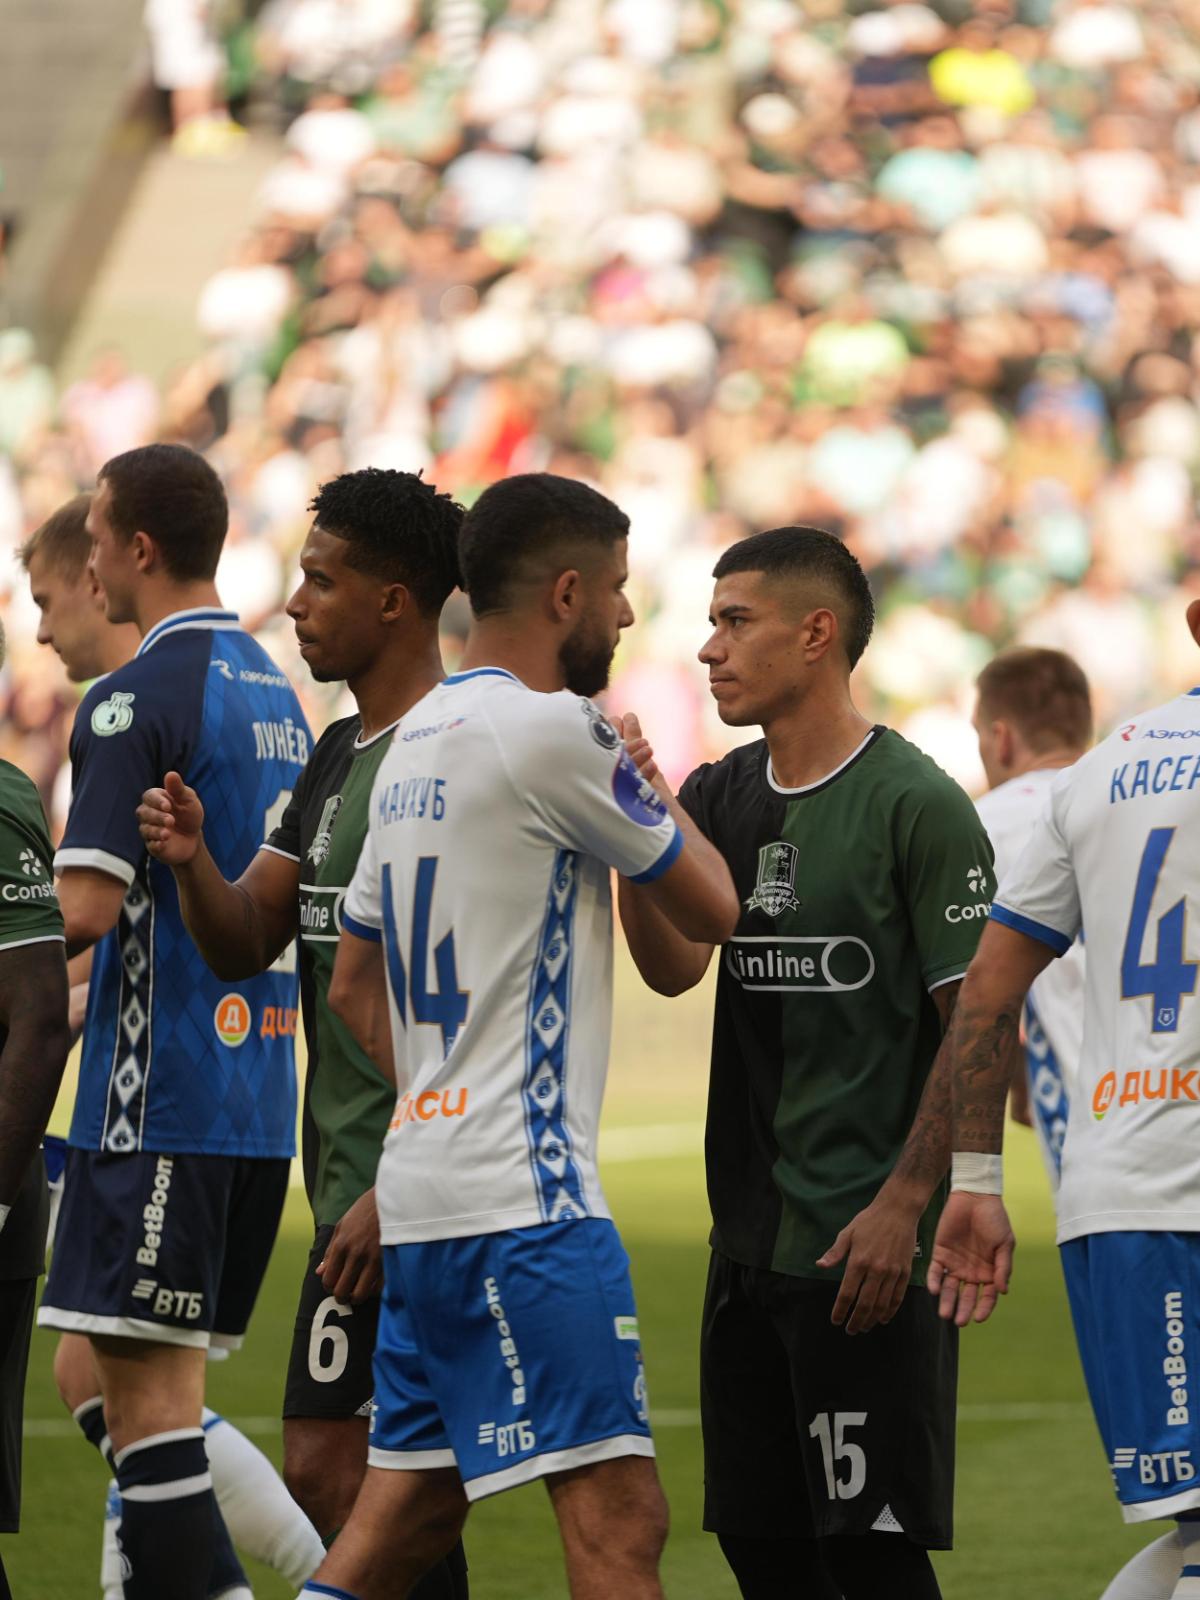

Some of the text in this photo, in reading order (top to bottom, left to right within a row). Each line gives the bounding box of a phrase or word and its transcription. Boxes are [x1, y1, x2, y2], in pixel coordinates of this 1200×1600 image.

[252, 717, 308, 767] ЛУНЁВ
[380, 855, 471, 1061] 14
[733, 949, 815, 978] inline
[153, 1288, 203, 1320] ВТБ
[308, 1296, 353, 1383] 6
[484, 1276, 527, 1406] BetBoom
[1163, 1291, 1190, 1427] BetBoom
[496, 1420, 536, 1457] ВТБ
[809, 1412, 868, 1500] 15
[1139, 1450, 1196, 1485] ВТБ
